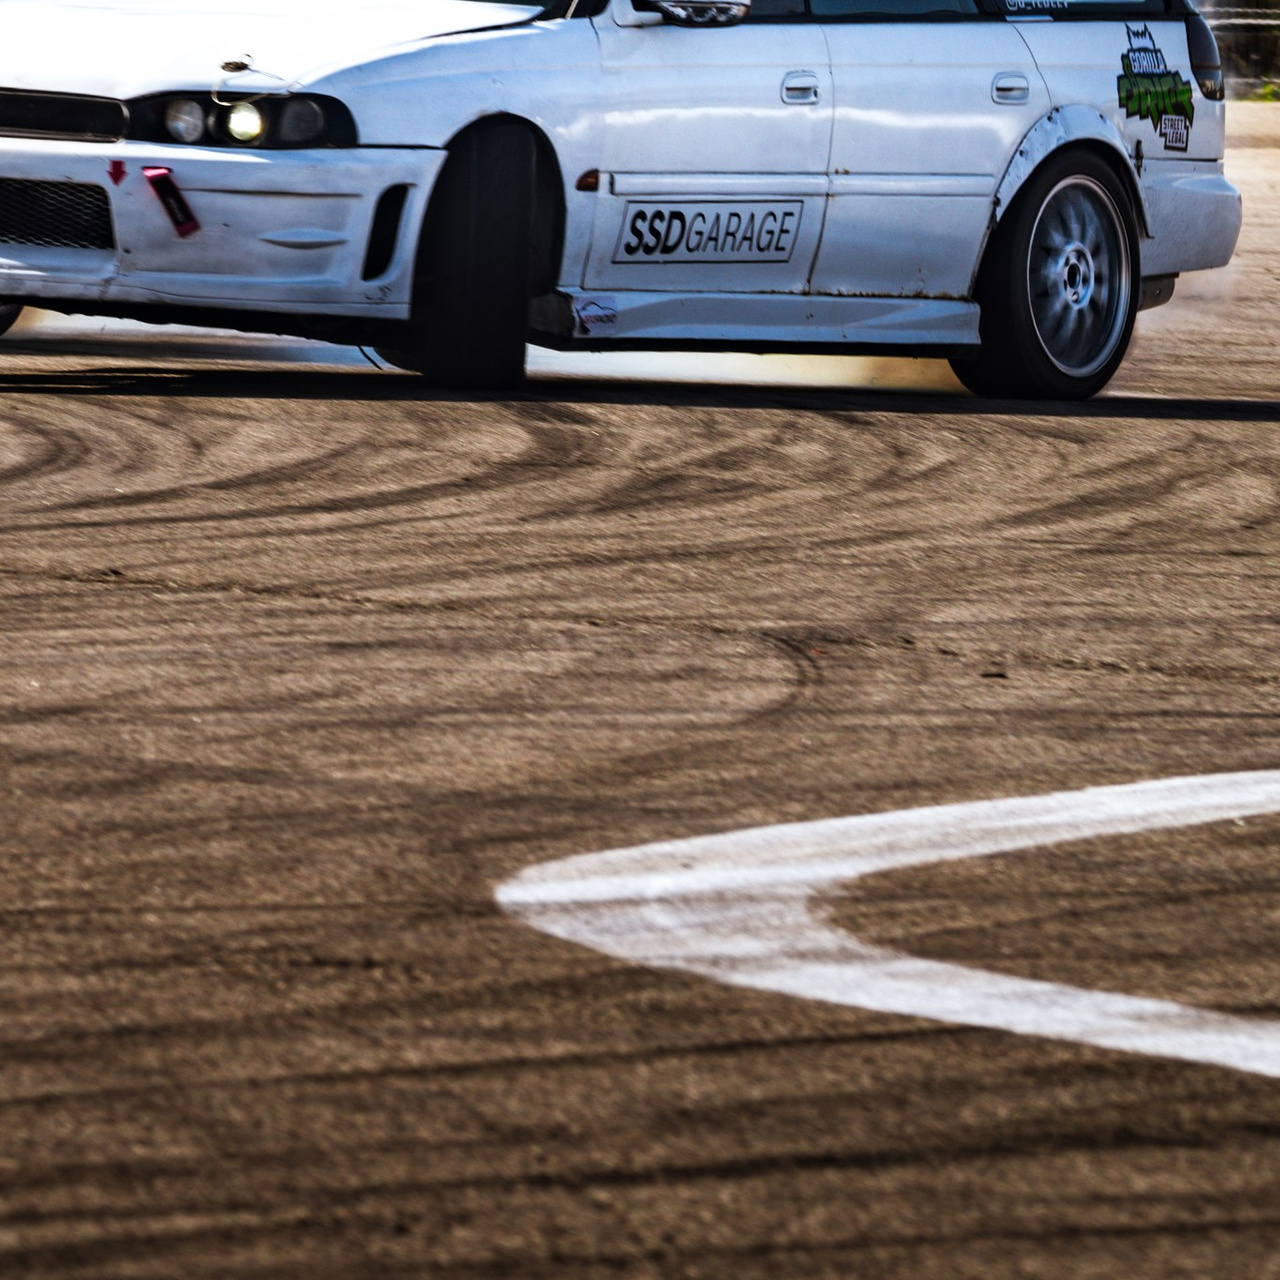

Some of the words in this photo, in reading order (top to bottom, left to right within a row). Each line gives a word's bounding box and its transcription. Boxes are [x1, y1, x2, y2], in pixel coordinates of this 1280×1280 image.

[1129, 51, 1167, 75] GORILLA
[1163, 116, 1186, 131] STREET
[1167, 131, 1185, 145] LEGAL
